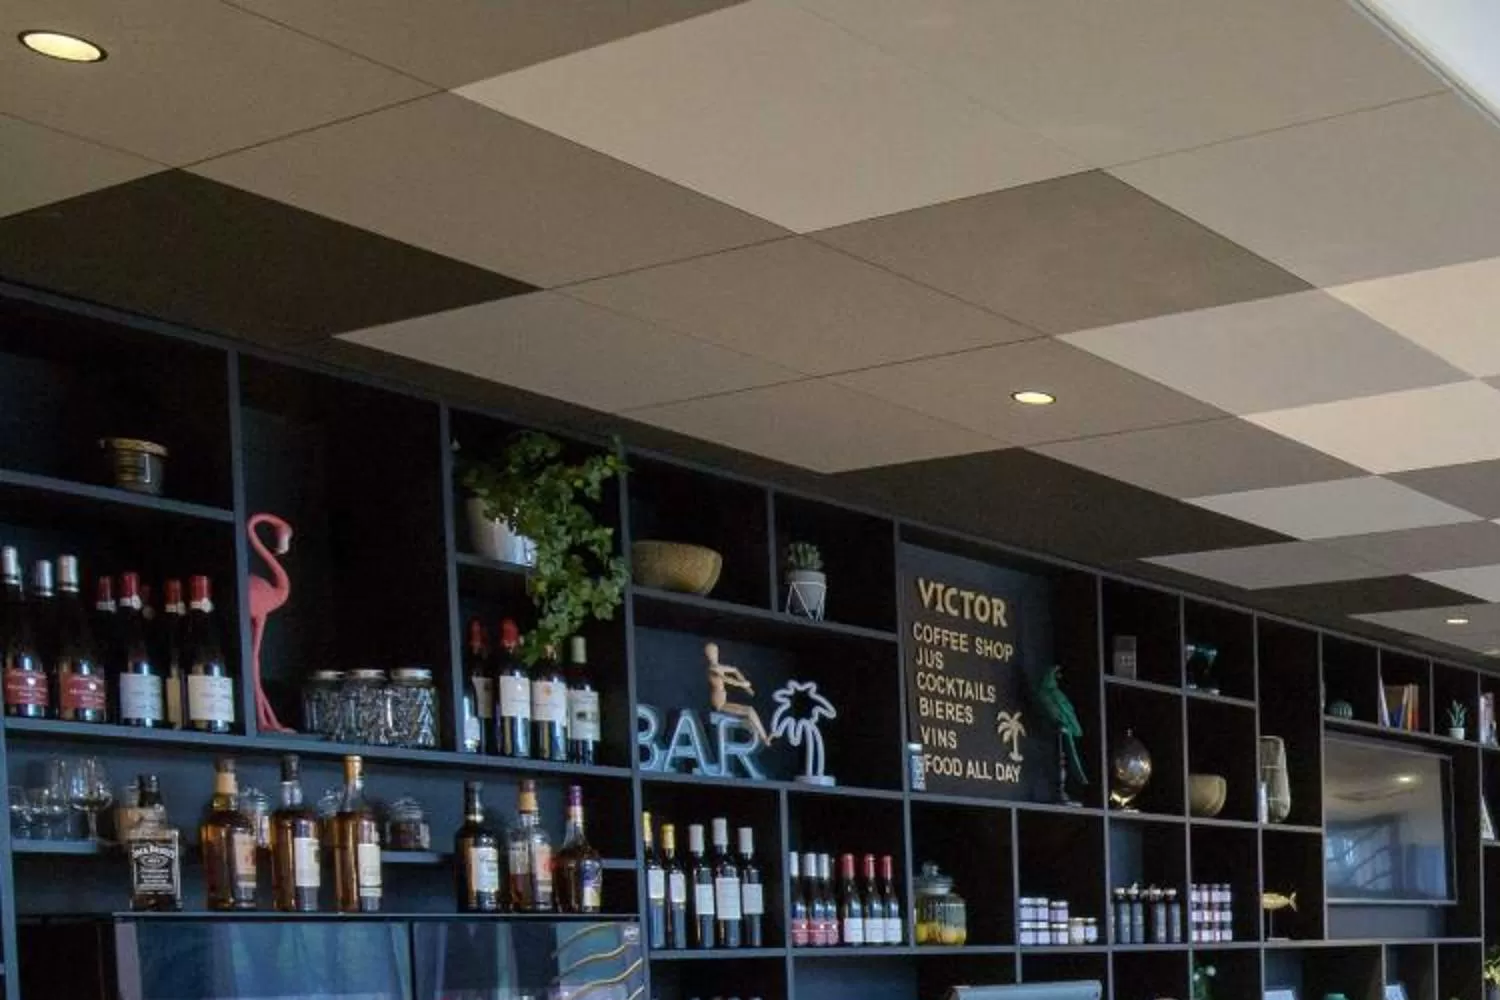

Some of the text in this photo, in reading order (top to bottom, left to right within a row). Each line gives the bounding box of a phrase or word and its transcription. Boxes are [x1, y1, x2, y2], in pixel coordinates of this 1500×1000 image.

[918, 577, 1008, 628] VICTOR
[913, 621, 1013, 662] COFFEE SHOP
[915, 647, 944, 670] JUS
[916, 671, 997, 703] COCKTAILS
[919, 697, 974, 724] BIERES
[636, 703, 768, 779] BAR
[920, 725, 957, 749] VINS
[924, 753, 963, 777] FOOD
[965, 760, 993, 780] ALL
[995, 762, 1021, 783] DAY
